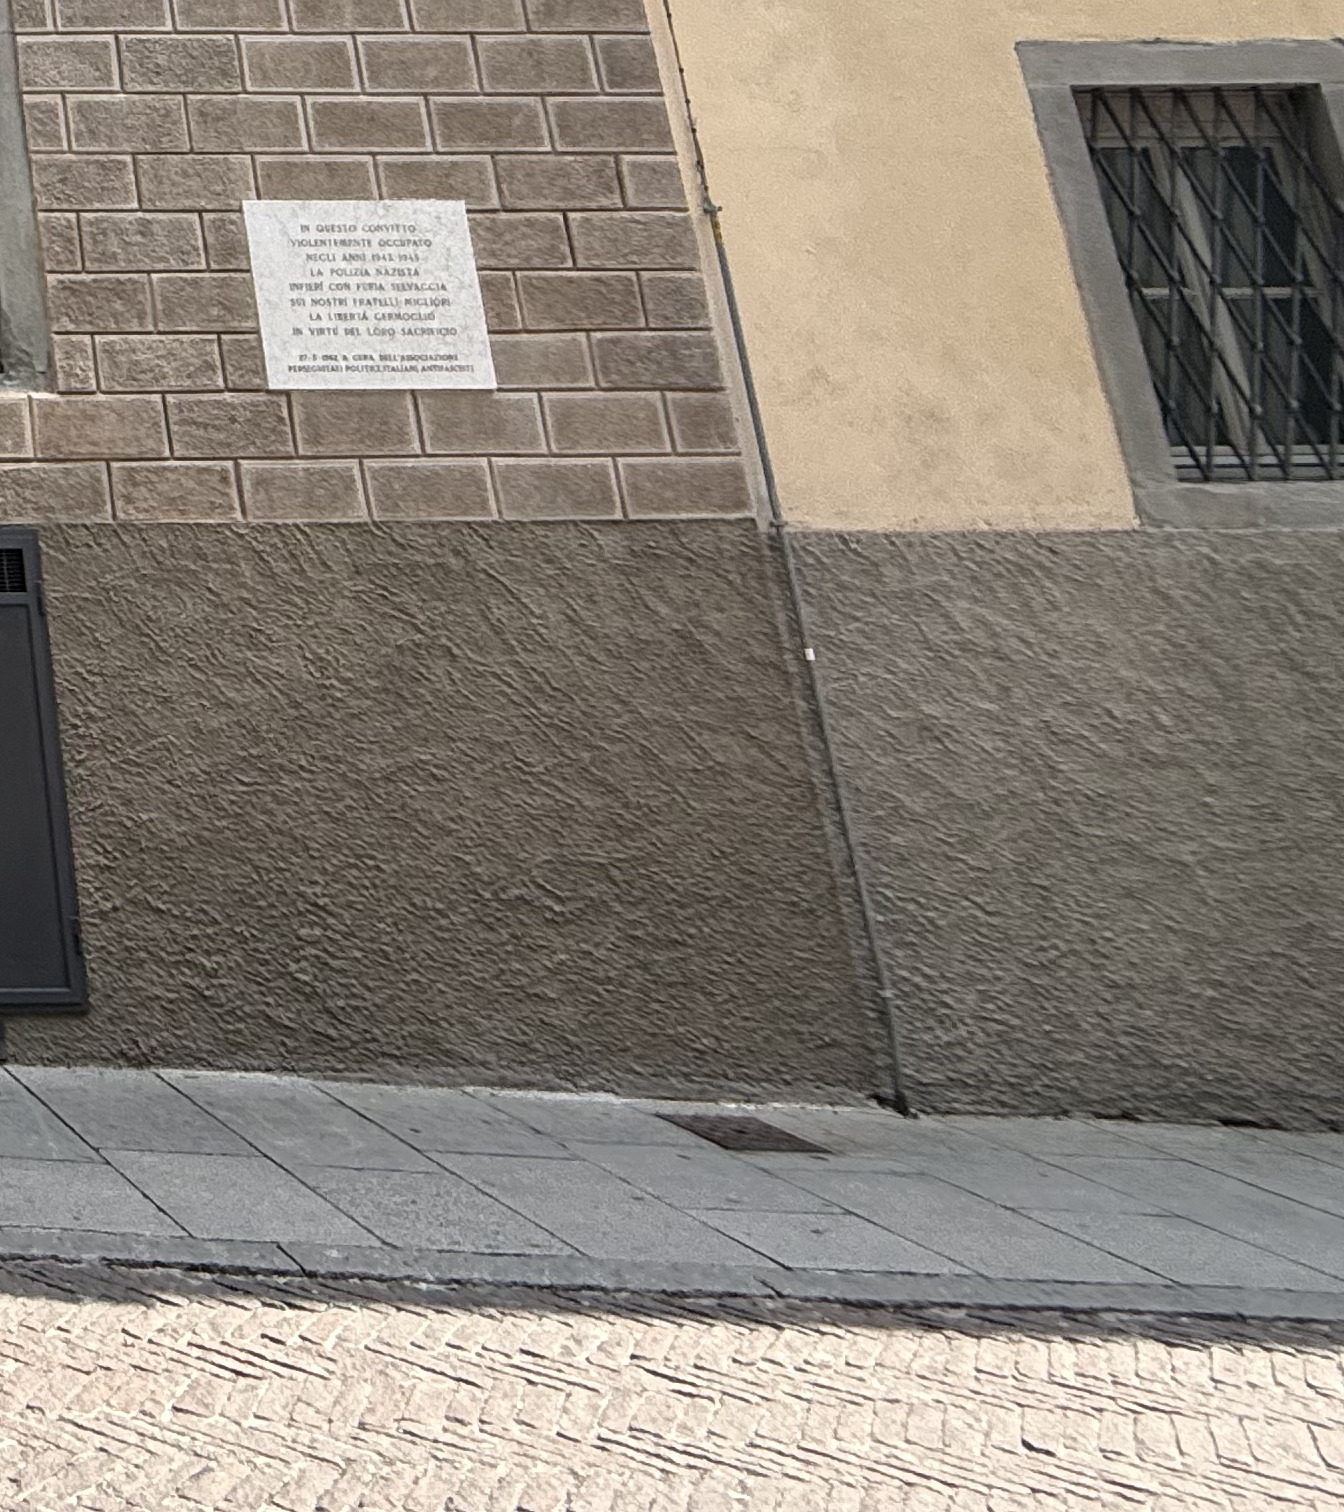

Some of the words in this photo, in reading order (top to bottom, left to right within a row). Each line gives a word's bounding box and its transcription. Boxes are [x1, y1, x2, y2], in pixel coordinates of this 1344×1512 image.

[300, 224, 311, 233] IN
[315, 224, 358, 233] QUESTO
[362, 224, 417, 233] CONVITTO
[378, 239, 433, 248] OCCUPATO
[341, 253, 366, 262] ANNI
[310, 267, 324, 277] LA
[330, 267, 371, 277] POLIZIA
[375, 267, 421, 277] NAZISTA
[328, 282, 351, 292] CON
[309, 312, 323, 322] LA
[292, 327, 303, 336] IN
[344, 327, 362, 336] DEL
